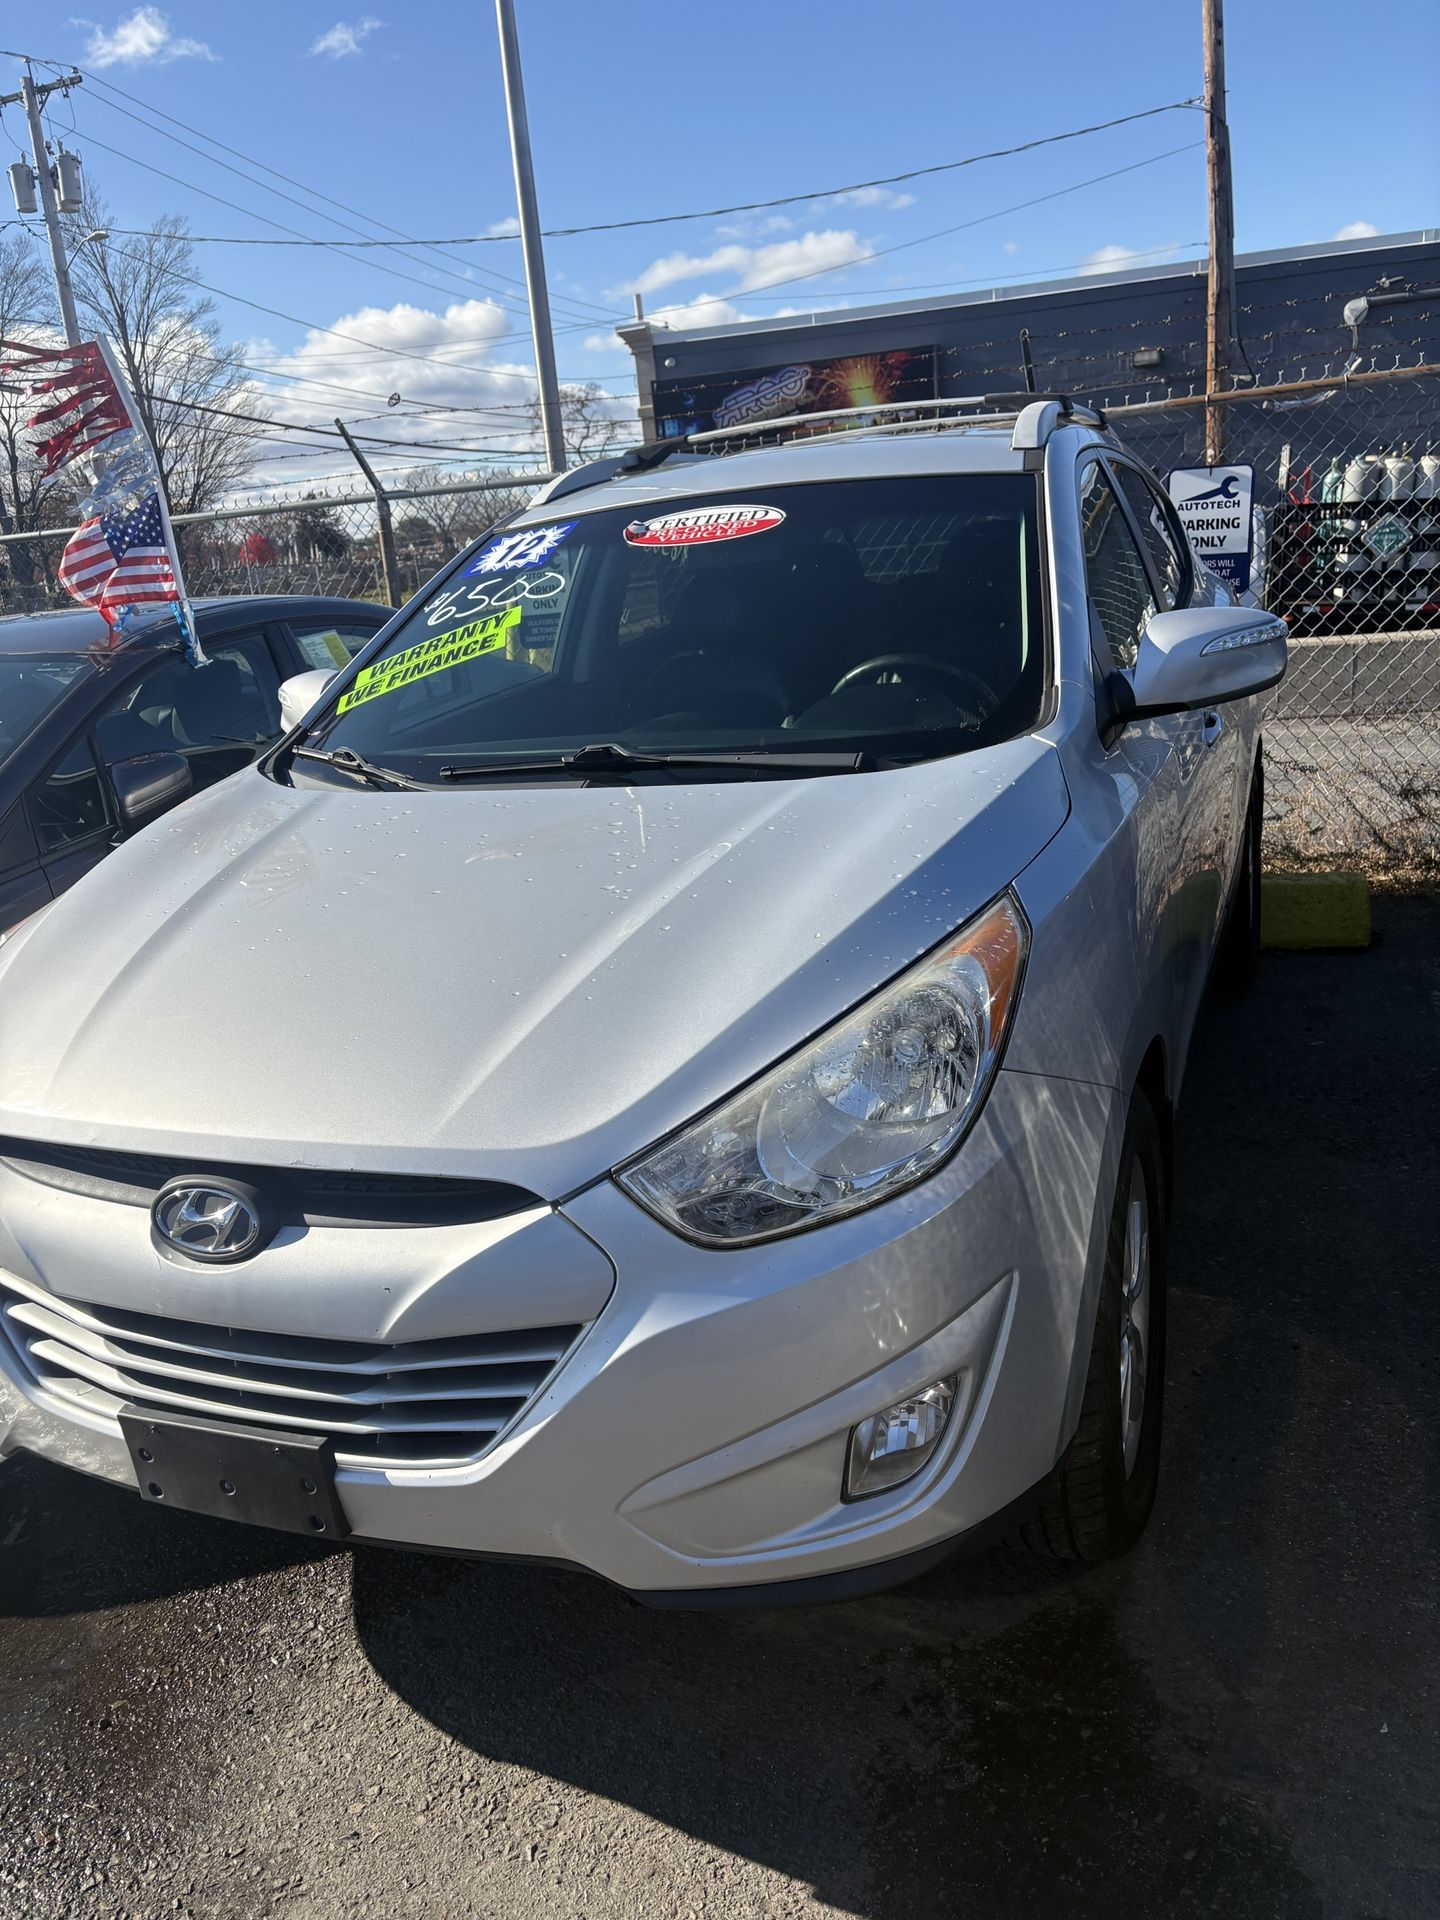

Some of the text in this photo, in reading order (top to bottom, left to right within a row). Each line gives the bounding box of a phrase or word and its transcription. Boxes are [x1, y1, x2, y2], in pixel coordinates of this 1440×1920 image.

[1177, 499, 1240, 511] AUTOTECH
[645, 520, 758, 539] PRE-OWNED
[646, 510, 769, 532] CERTIFIED
[659, 528, 739, 543] VEHICLE
[495, 533, 549, 564] 12
[1217, 559, 1235, 567] WILL
[1221, 569, 1231, 577] AT
[423, 571, 566, 626] $6500
[533, 598, 558, 610] ONLY
[368, 609, 511, 679] WARRANTY
[343, 677, 386, 708] WE
[386, 633, 498, 690] FINANCE
